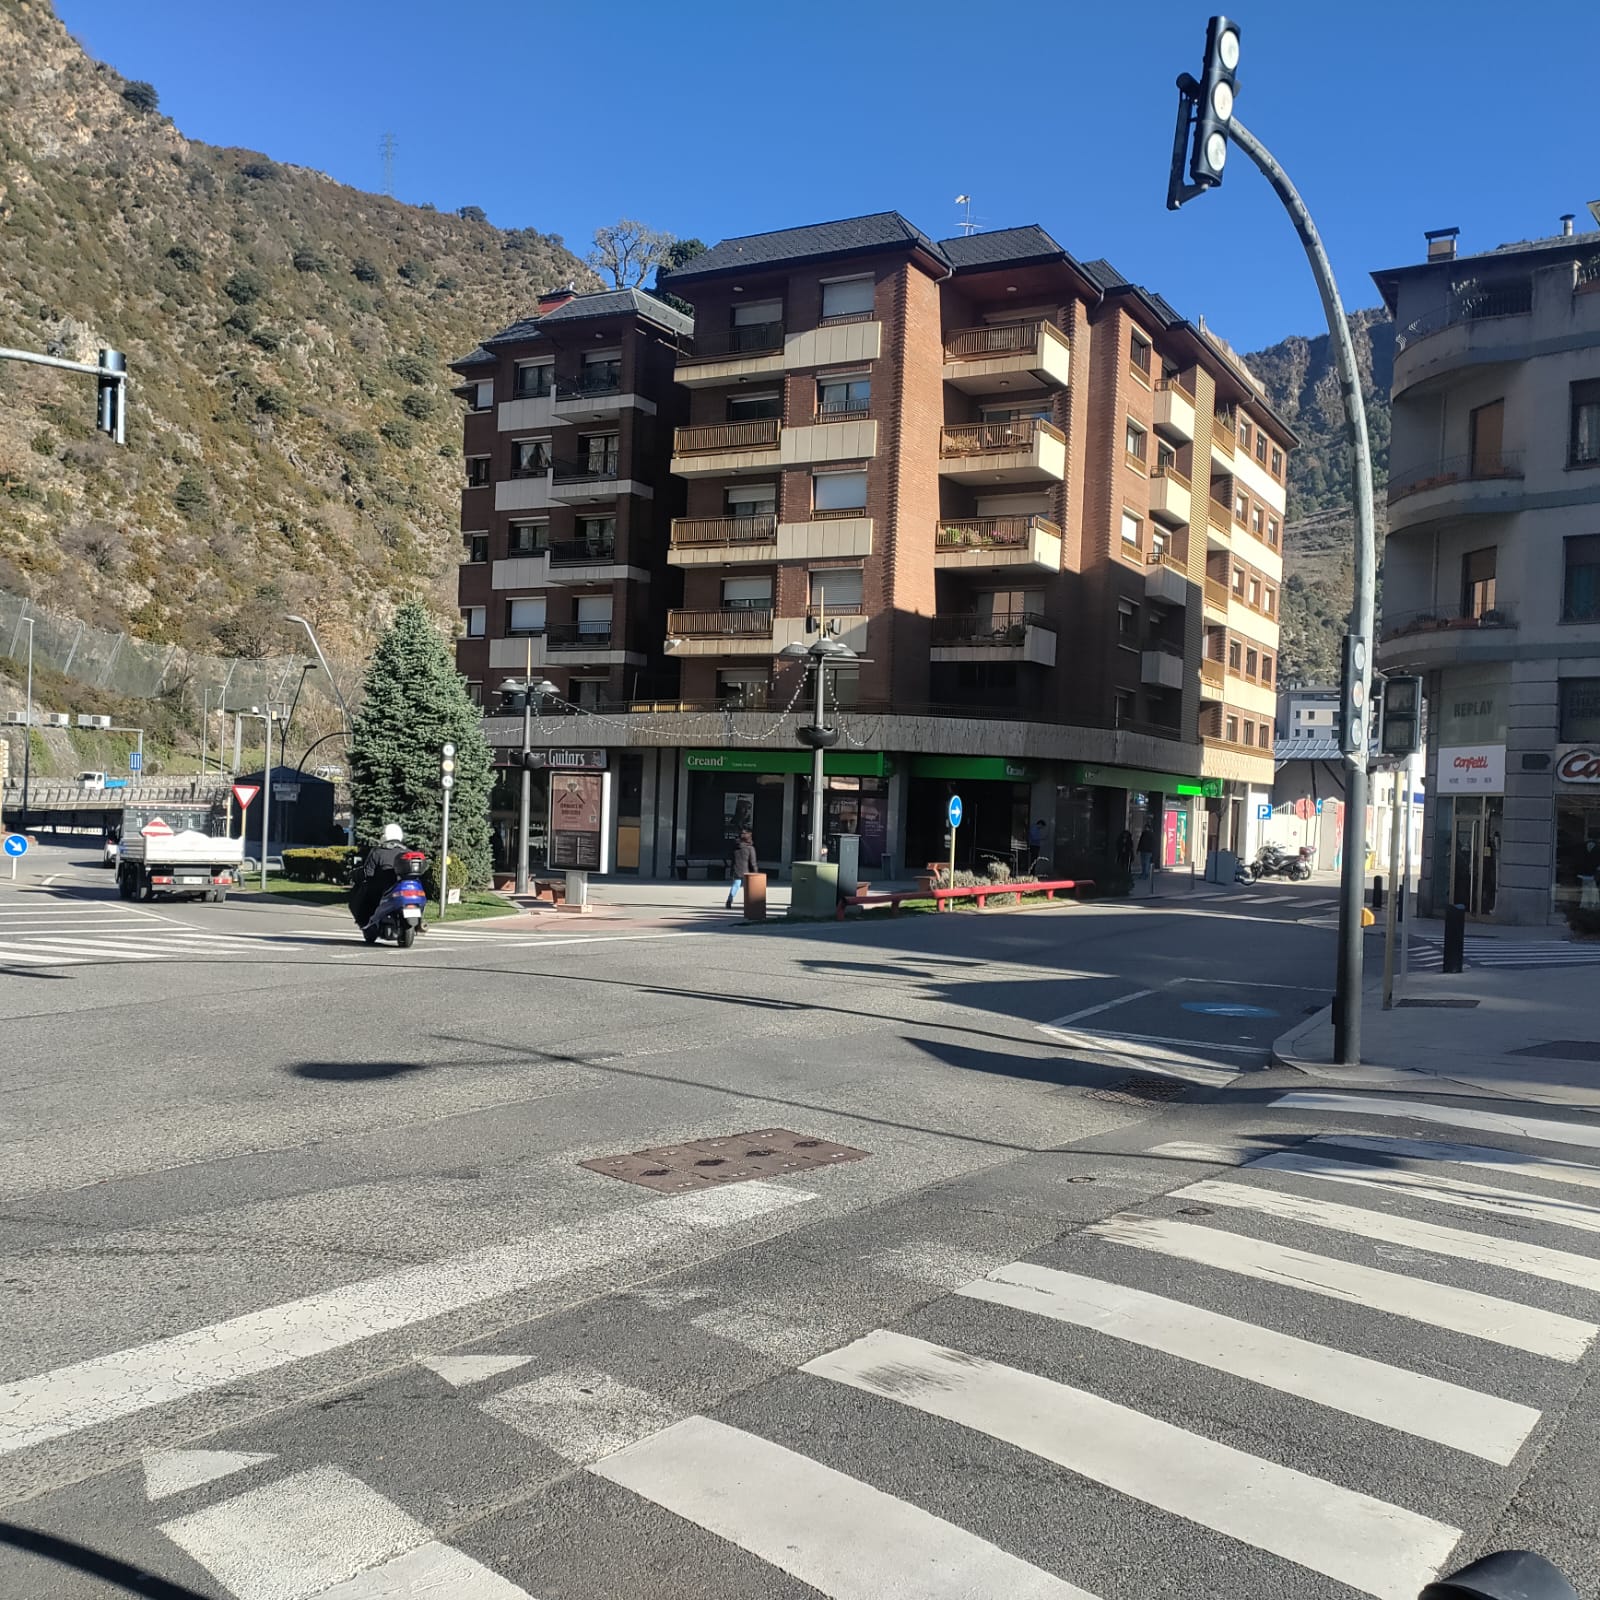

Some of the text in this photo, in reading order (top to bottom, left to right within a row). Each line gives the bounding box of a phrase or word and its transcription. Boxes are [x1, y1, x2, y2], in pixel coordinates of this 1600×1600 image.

[1454, 701, 1493, 717] REPLAY
[548, 749, 585, 768] Guitars
[687, 755, 724, 767] Creand
[1453, 756, 1489, 773] Confetti
[1259, 806, 1270, 819] P
